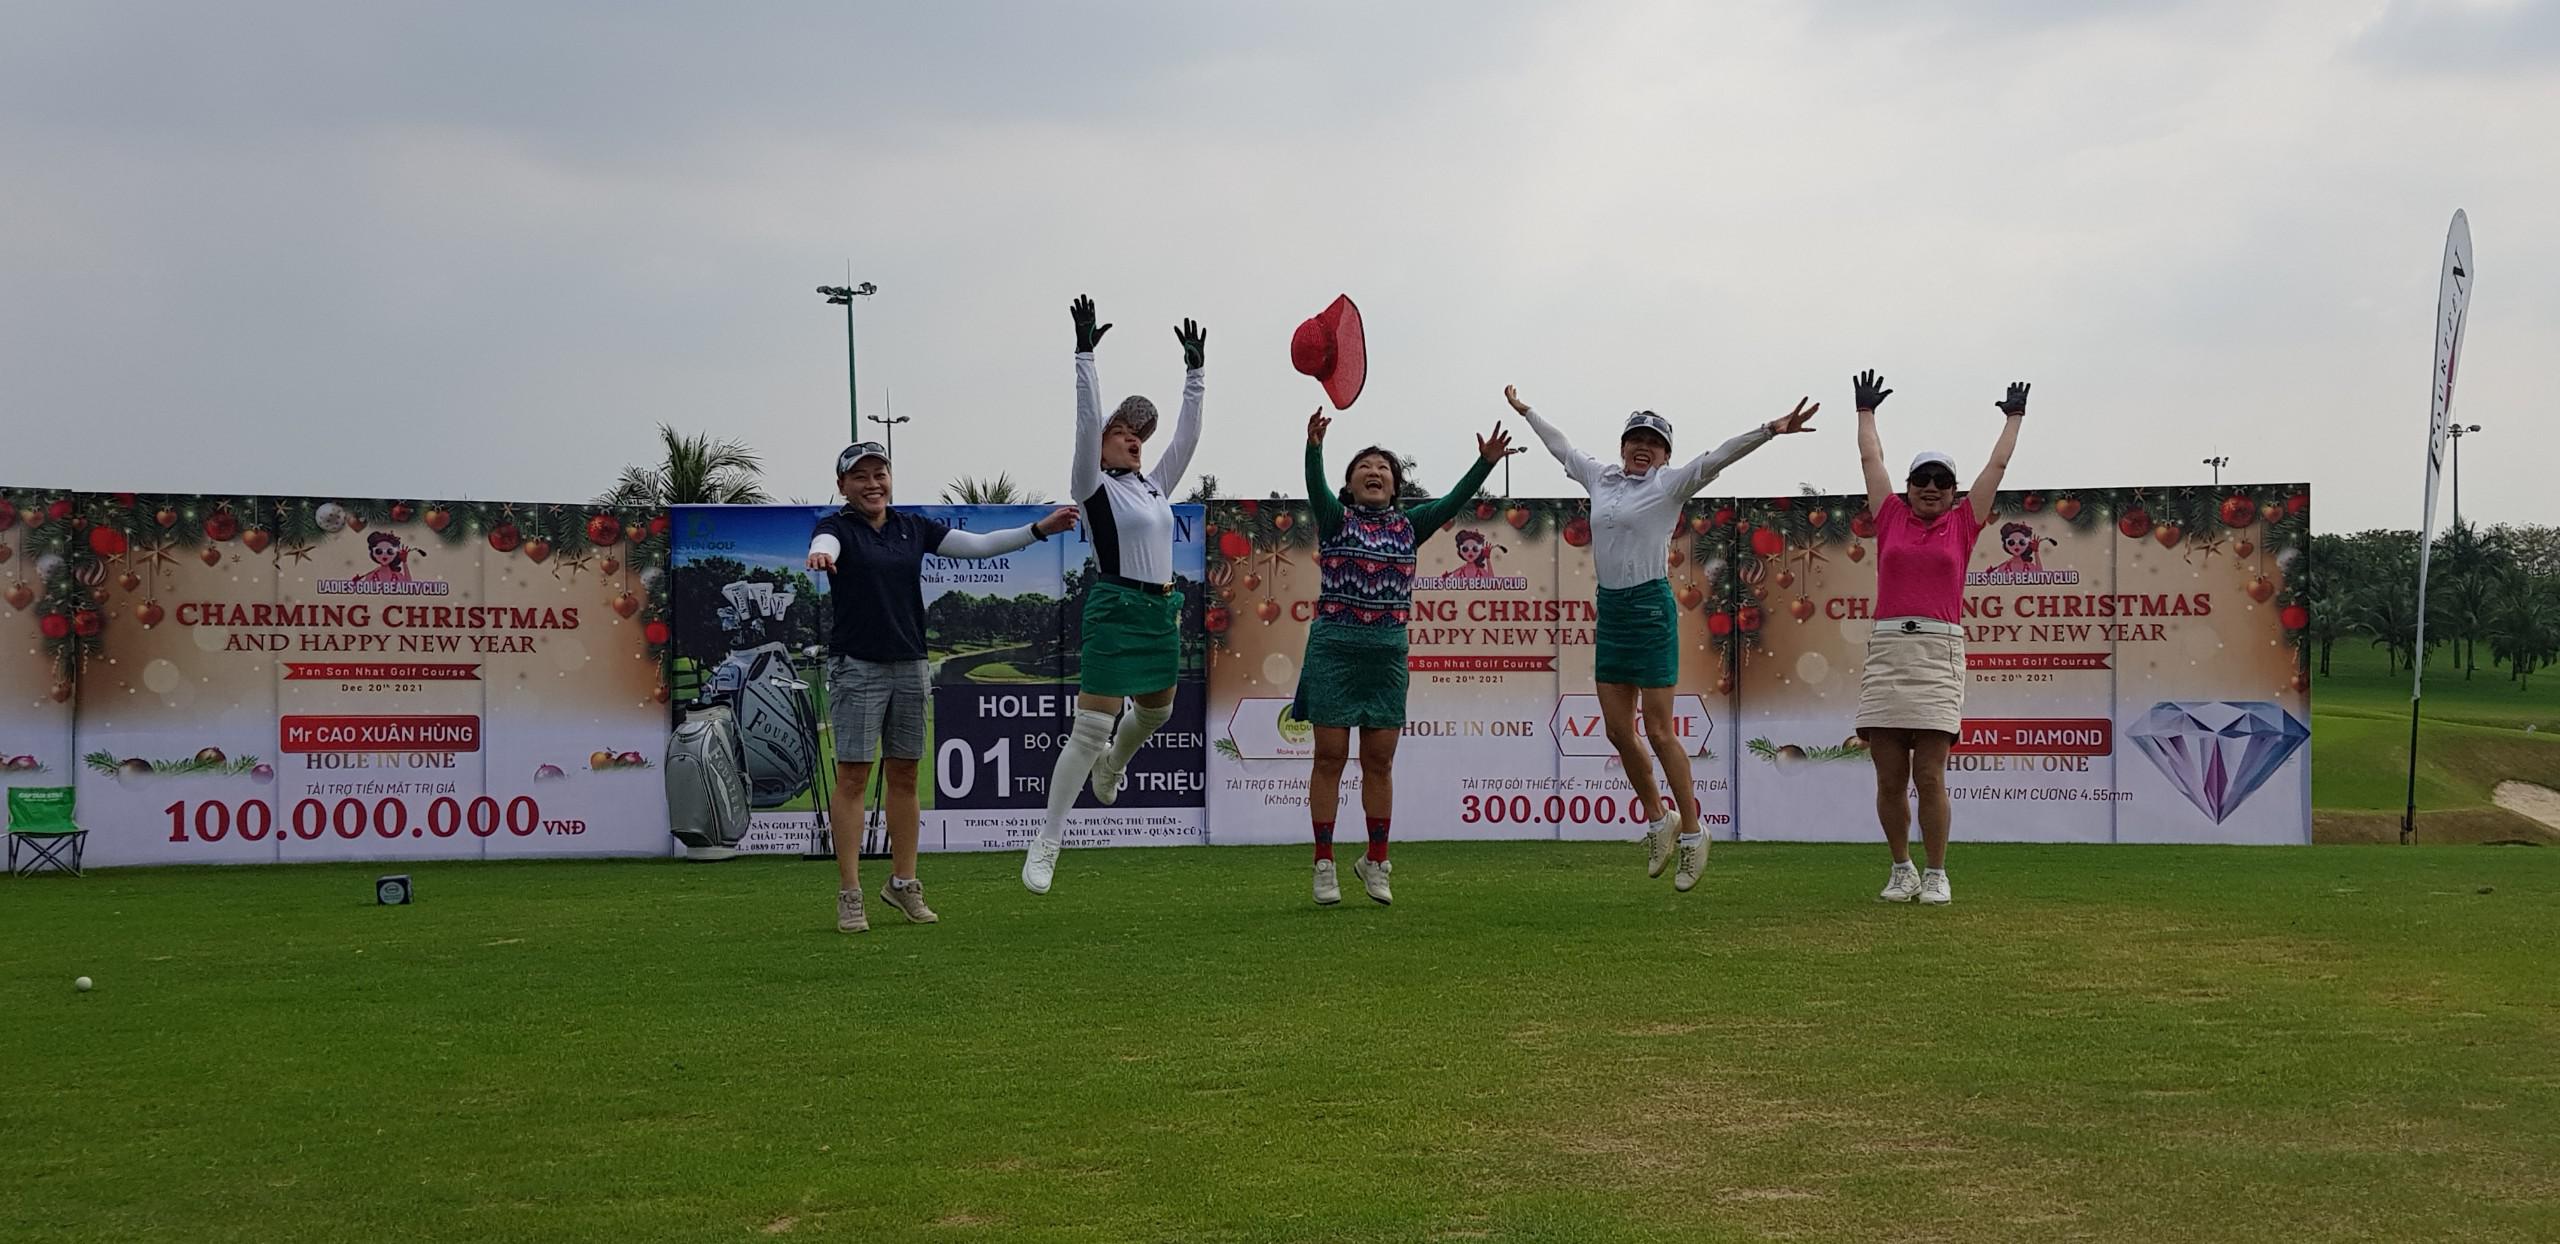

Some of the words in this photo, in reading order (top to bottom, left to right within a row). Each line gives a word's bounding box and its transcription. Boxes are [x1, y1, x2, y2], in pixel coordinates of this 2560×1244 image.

[925, 558, 960, 570] NEW
[967, 558, 1011, 570] YEAR
[953, 574, 1004, 583] 20/12/2021
[1412, 577, 1444, 590] LADIES
[1445, 577, 1469, 590] GOLF
[1469, 577, 1502, 590] BEAUTY
[1502, 577, 1528, 590] CLUB
[1966, 572, 1988, 586] DIES
[1990, 572, 2014, 585] GOLF
[2015, 571, 2052, 585] BEAUTY
[2053, 570, 2080, 584] CLUB
[317, 579, 354, 594] LADIES
[356, 580, 383, 595] GOLF
[384, 581, 423, 595] BEAUTY
[423, 581, 449, 595] CLUB
[2014, 593, 2212, 618] CHRISTMAS
[176, 602, 371, 627] CHARMING
[382, 604, 580, 630] CHRISTMAS
[1483, 629, 1538, 645] NEW
[1963, 624, 2022, 642] APPY
[2029, 624, 2094, 642] NEW
[2097, 623, 2168, 642] YEAR
[224, 633, 290, 651] AND
[299, 634, 391, 652] HAPPY
[398, 635, 461, 653] NEW
[468, 635, 537, 654] YEAR
[1419, 660, 1440, 669] Son
[1444, 660, 1470, 669] Nhat
[1475, 660, 1498, 669] Golf
[1503, 660, 1543, 669] Course
[1989, 657, 2017, 666] Nhat
[2022, 657, 2047, 666] Golf
[2052, 656, 2096, 666] Course
[298, 667, 321, 676] Tan
[326, 667, 350, 676] Son
[355, 667, 384, 676] Nhat
[390, 666, 417, 677] Golf
[422, 667, 466, 677] Course
[1976, 674, 1996, 682] Dec
[2027, 674, 2054, 682] 2021
[341, 684, 363, 692] Dec
[395, 684, 422, 692] 2021
[978, 695, 1056, 717] HOLE
[288, 727, 312, 743] Mr
[316, 726, 356, 742] CAO
[361, 722, 415, 742] XUÂN
[420, 722, 473, 742] HÙNG
[1401, 721, 1457, 737] HOLE
[1463, 721, 1484, 737] IN
[1490, 720, 1534, 737] ONE
[1024, 732, 1050, 752] BỘ
[1959, 729, 1997, 745] LAN
[2016, 729, 2103, 745] DIAMOND
[306, 753, 370, 769] HOLE
[376, 753, 400, 768] IN
[408, 752, 456, 769] ONE
[936, 737, 1011, 799] 01
[1946, 755, 2004, 772] HOLE
[2011, 755, 2034, 771] IN
[2042, 755, 2089, 772] ONE
[306, 782, 325, 795] TÀI
[328, 783, 354, 796] TRỢ
[414, 783, 434, 796] TRỊ
[436, 781, 456, 794] GIÁ
[1014, 776, 1046, 795] TRỊ
[1135, 769, 1204, 795] TRIỆU
[1226, 778, 1242, 790] TÀI
[1245, 779, 1267, 792] TRỢ
[1268, 779, 1275, 790] 6
[1462, 777, 1479, 789] TÀI
[1481, 778, 1504, 792] TRỢ
[1526, 776, 1559, 790] THIẾT
[1584, 778, 1602, 790] THI
[1709, 777, 1728, 790] GIÁ
[1264, 794, 1304, 807] (Không
[1953, 789, 1967, 799] 01
[1970, 785, 2001, 800] VIÊN
[2004, 788, 2027, 800] KIM
[2030, 788, 2078, 800] CƯƠNG
[2080, 789, 2133, 801] 4.55mm
[165, 796, 540, 842] 100.000.000
[543, 820, 586, 836] VNĐ
[772, 822, 796, 830] GOLF
[964, 819, 999, 827] TP.HCM
[1703, 814, 1730, 825] VNĐ
[1069, 828, 1089, 836] KHU
[1091, 828, 1117, 836] LAKE
[1118, 828, 1141, 836] VIEW
